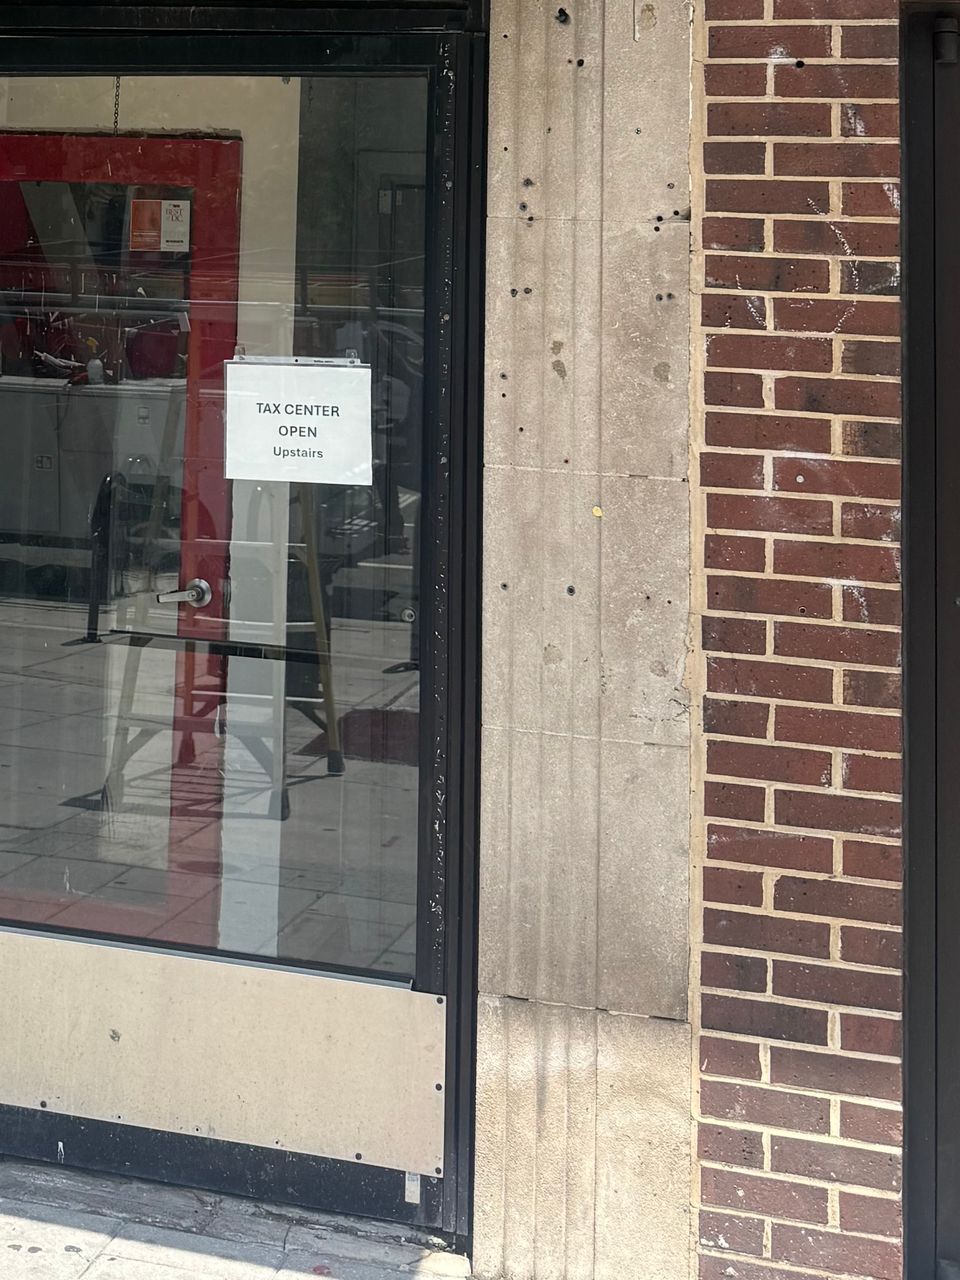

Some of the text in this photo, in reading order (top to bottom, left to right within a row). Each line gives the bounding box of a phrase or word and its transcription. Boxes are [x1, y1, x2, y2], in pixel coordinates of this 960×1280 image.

[256, 402, 340, 417] TAX CENTER
[278, 425, 318, 438] OPEN
[273, 446, 324, 459] Upstairs
